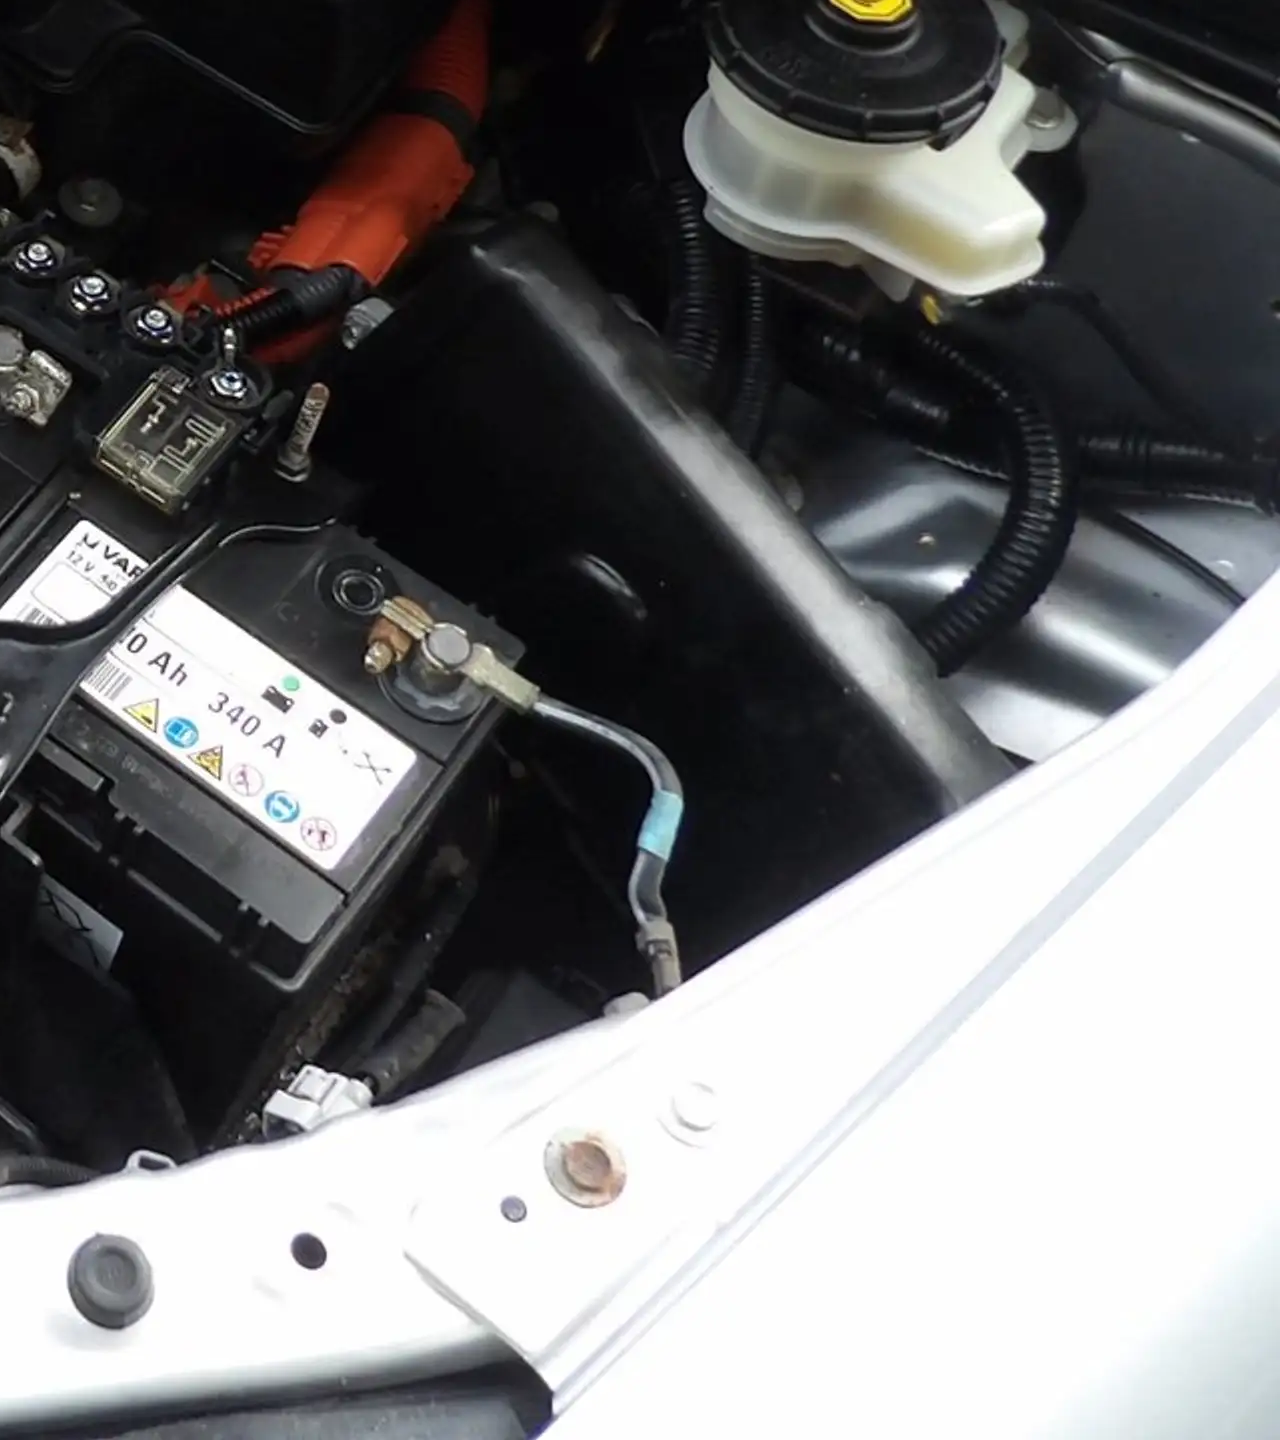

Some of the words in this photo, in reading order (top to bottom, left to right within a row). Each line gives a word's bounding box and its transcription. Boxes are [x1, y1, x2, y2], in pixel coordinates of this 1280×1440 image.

[147, 651, 189, 687] Ah
[207, 691, 262, 737] 340
[262, 733, 288, 759] A
